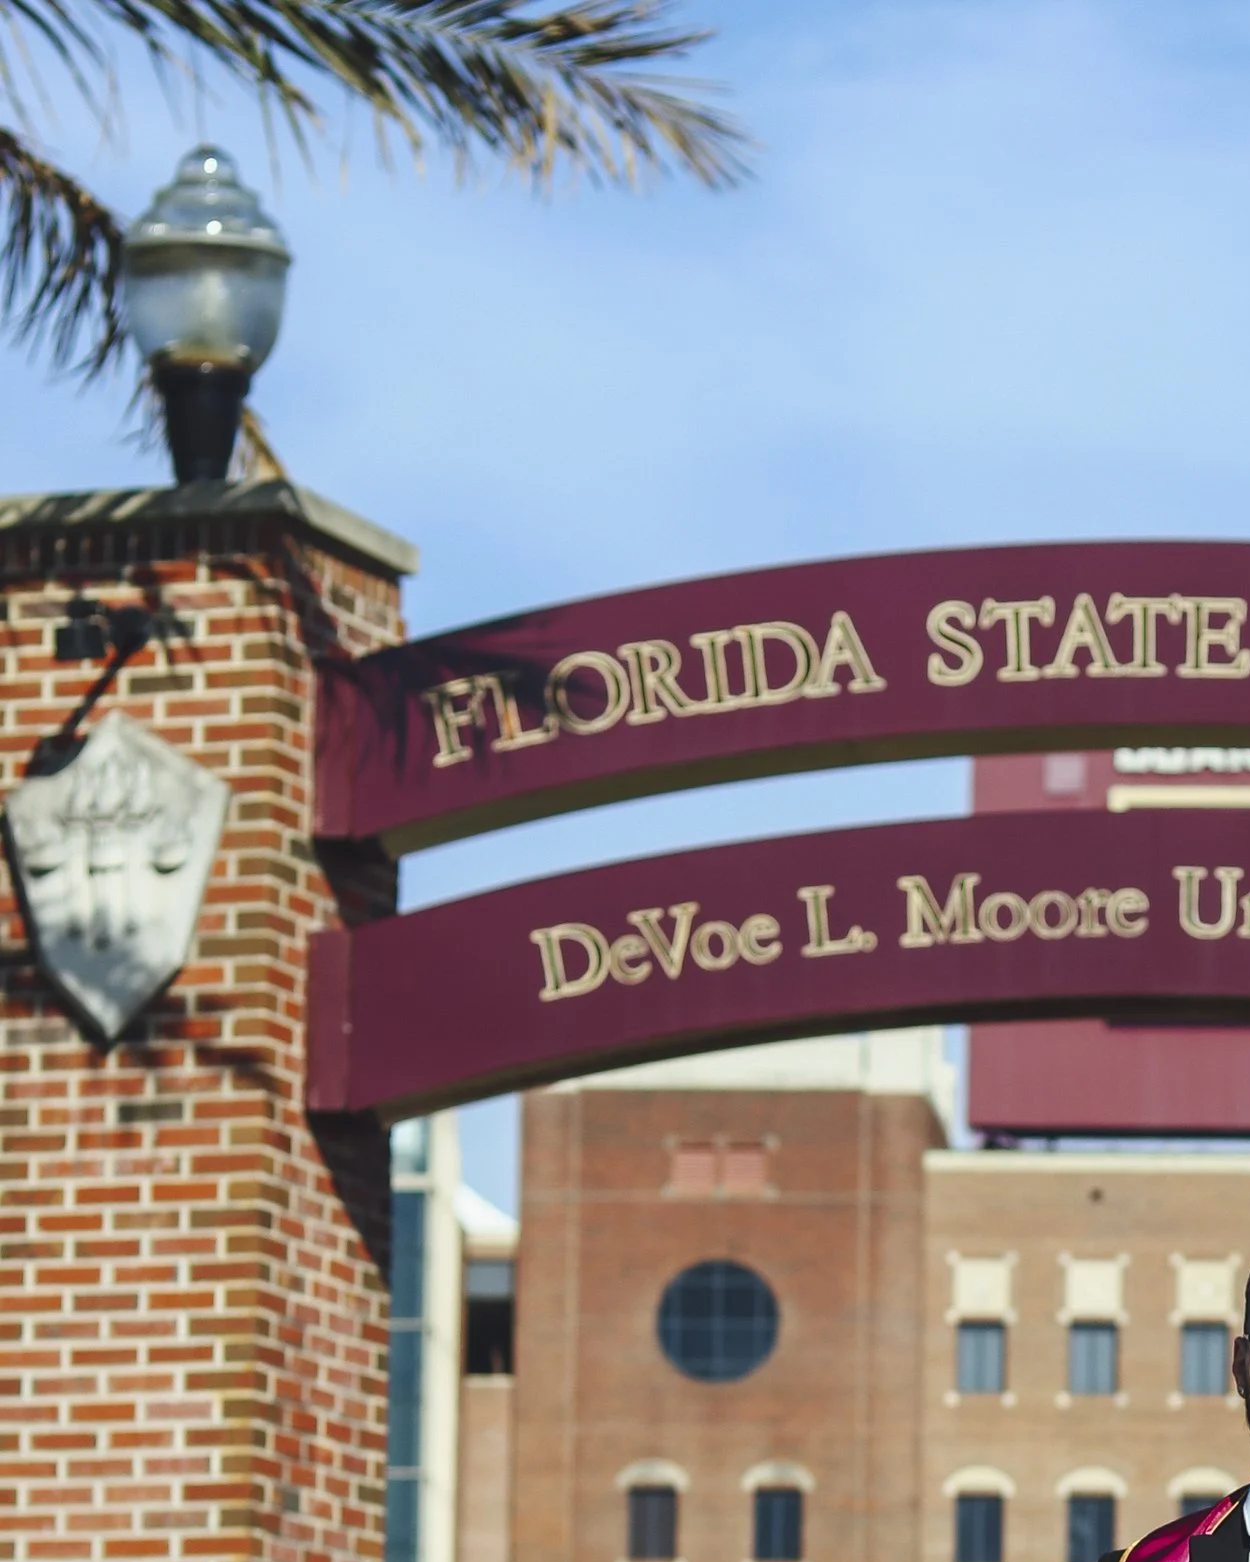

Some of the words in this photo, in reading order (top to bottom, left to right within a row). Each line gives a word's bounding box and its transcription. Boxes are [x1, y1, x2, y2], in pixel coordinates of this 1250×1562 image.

[425, 610, 886, 768] FLORIDA
[530, 902, 782, 1002] DeVoe
[797, 885, 878, 958] L.
[897, 873, 1150, 949] Moore
